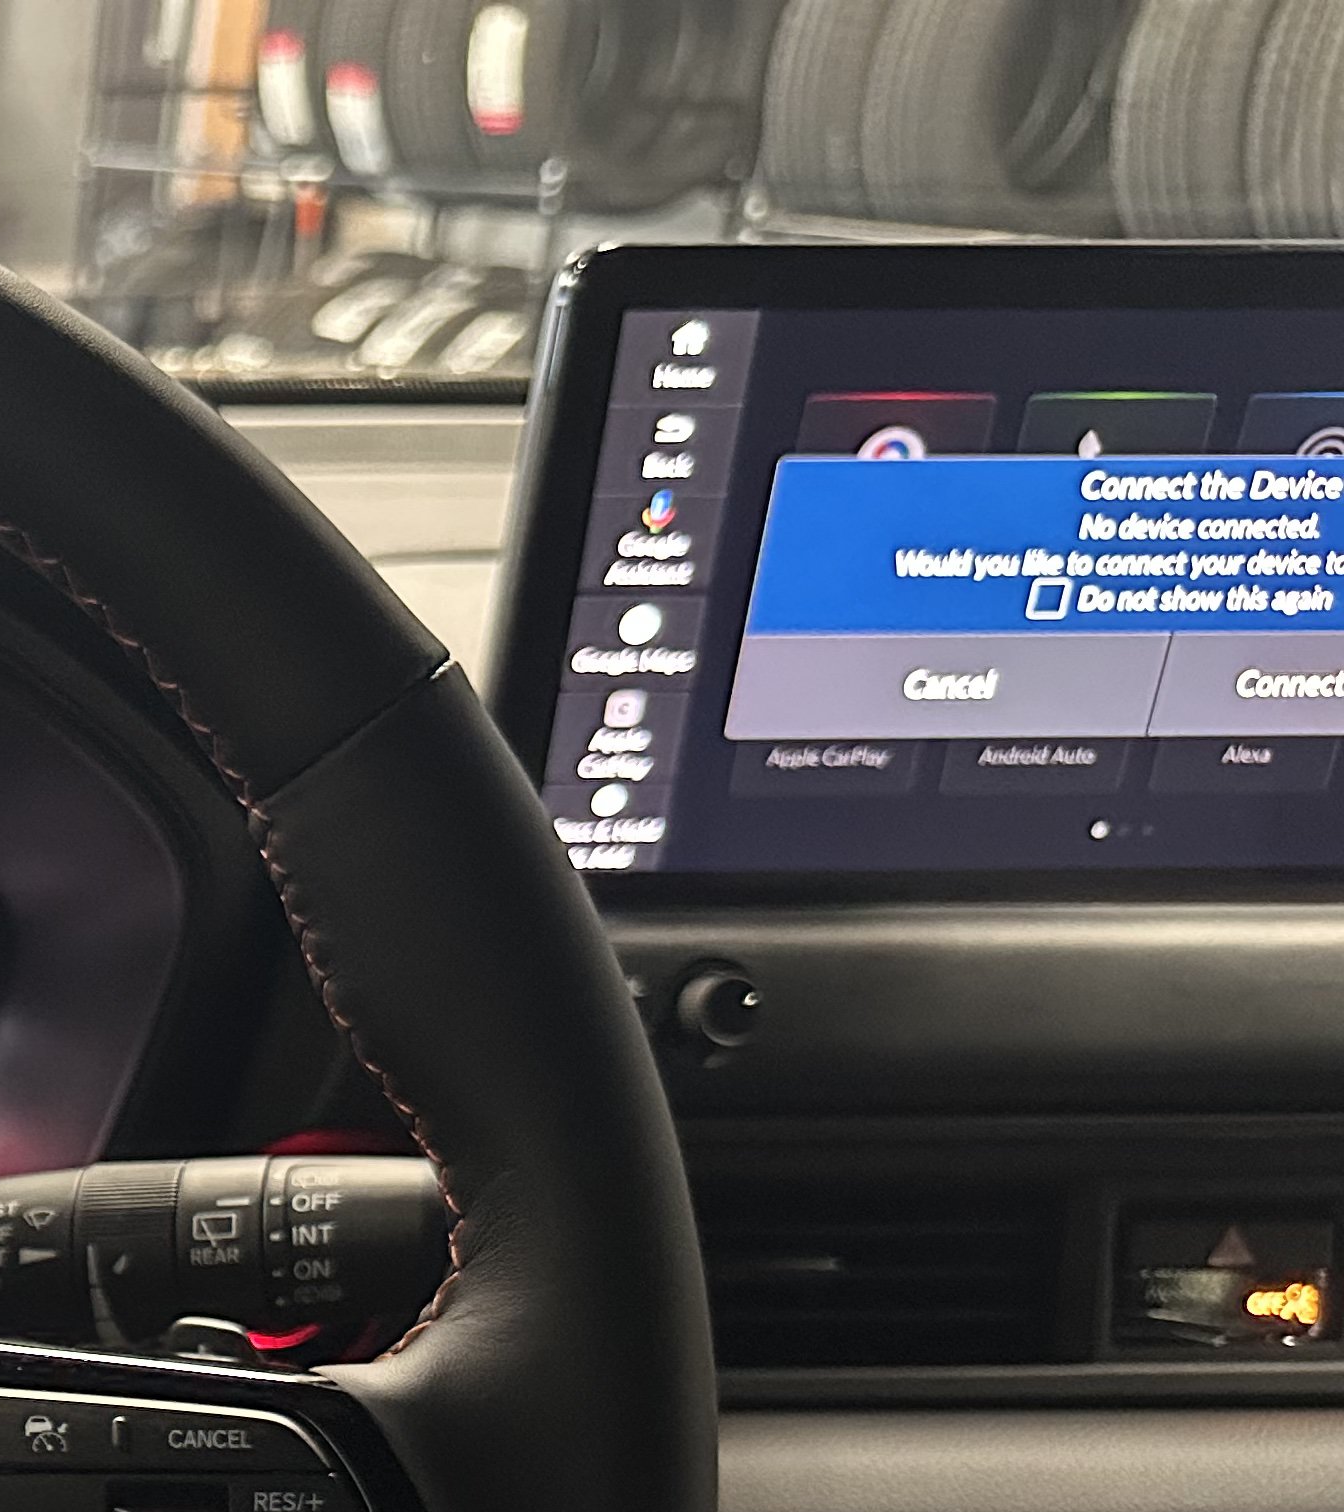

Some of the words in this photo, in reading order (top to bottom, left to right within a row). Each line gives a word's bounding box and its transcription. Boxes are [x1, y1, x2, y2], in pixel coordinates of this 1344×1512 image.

[1080, 469, 1197, 501] Connect
[1198, 470, 1246, 501] the
[1248, 469, 1344, 501] Device
[1078, 513, 1116, 541] No
[1117, 512, 1195, 541] device
[1196, 512, 1321, 541] connected.
[895, 548, 972, 577] Would
[973, 554, 1020, 581] you
[1021, 548, 1064, 577] like
[1065, 550, 1094, 576] to
[1094, 551, 1191, 577] connect
[1190, 554, 1245, 580] your
[1245, 549, 1322, 576] device
[1077, 585, 1116, 613] Do
[1116, 586, 1159, 613] not
[1159, 585, 1223, 612] show
[1226, 585, 1270, 612] this
[1271, 586, 1333, 616] again
[903, 668, 1000, 701] Cancel
[765, 746, 820, 770] Apple
[822, 746, 892, 770] CarPlay
[977, 746, 1049, 766] Android
[1050, 746, 1097, 766] Auto
[1221, 746, 1273, 765] Alexa
[291, 1193, 341, 1212] OFF
[291, 1222, 335, 1246] INT
[190, 1247, 240, 1266] REAR
[293, 1259, 331, 1281] ON
[168, 1429, 252, 1449] CANCEL
[254, 1492, 324, 1512] RES/+
